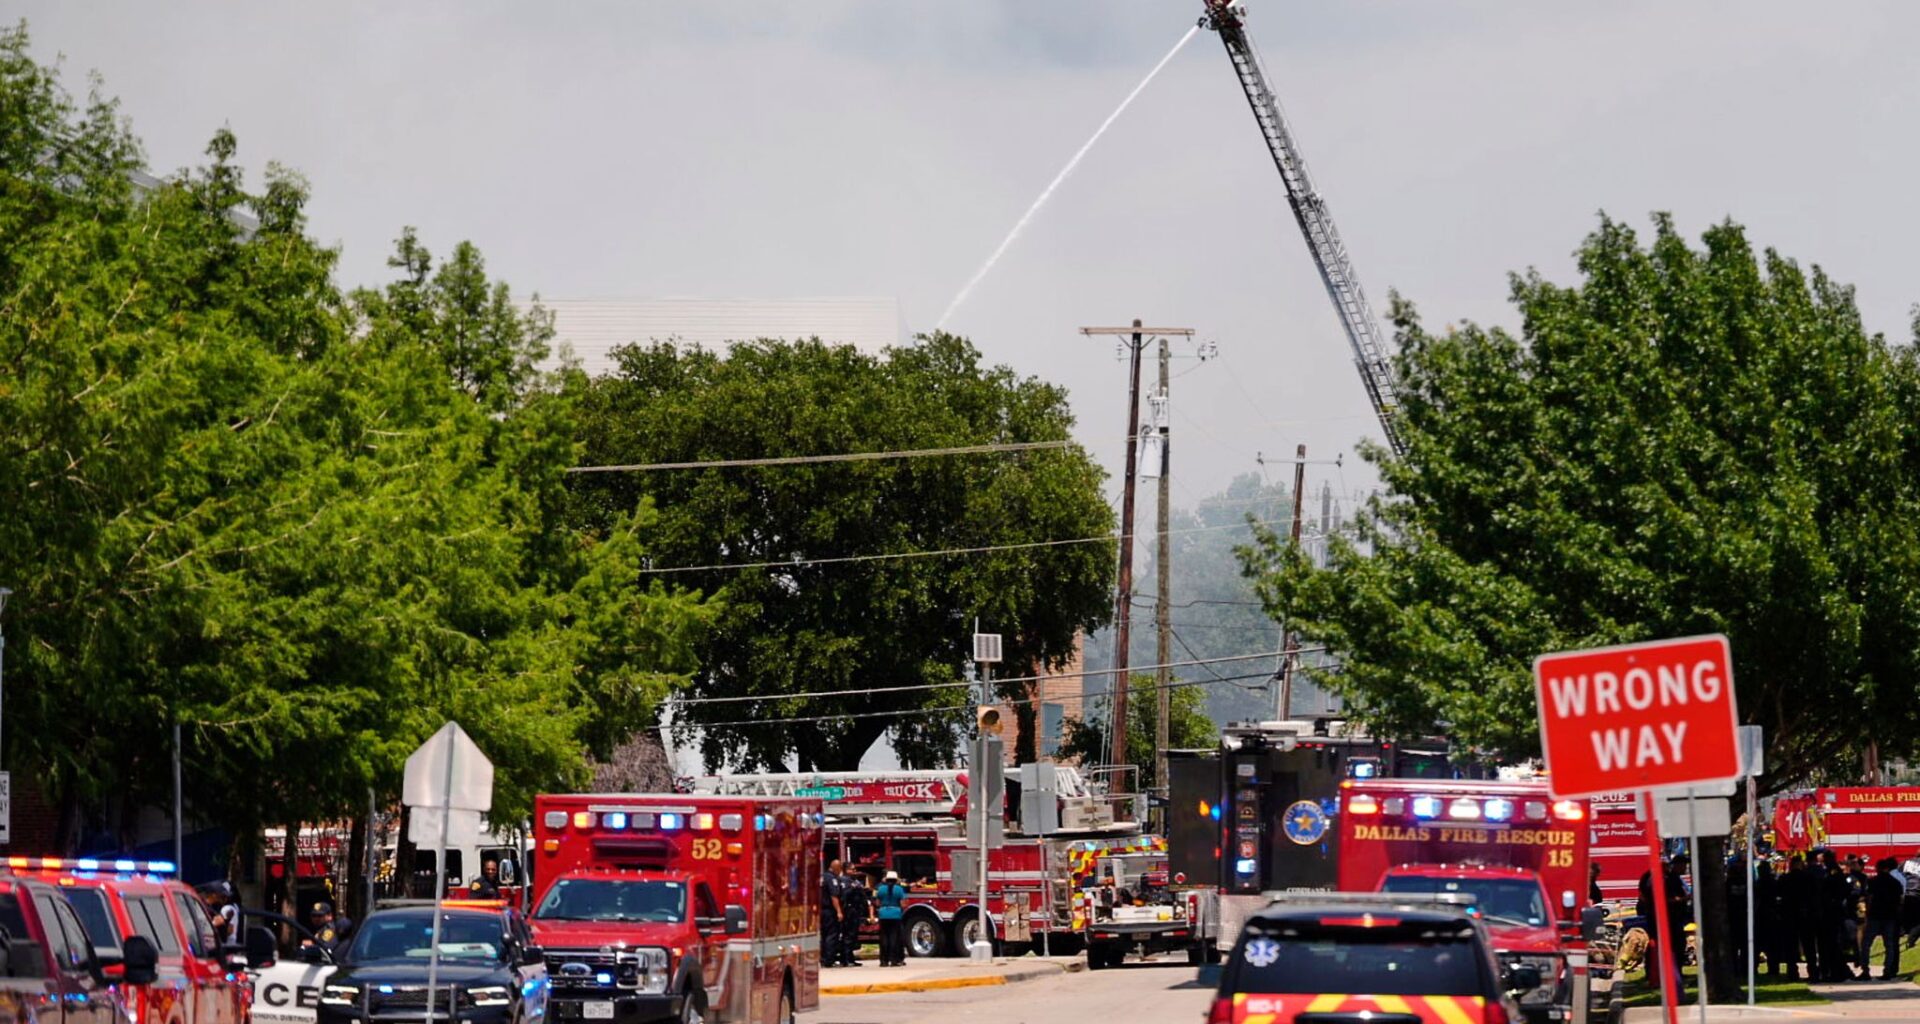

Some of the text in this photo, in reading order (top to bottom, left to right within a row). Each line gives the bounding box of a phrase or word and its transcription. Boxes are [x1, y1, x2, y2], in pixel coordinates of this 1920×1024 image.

[1549, 660, 1721, 718] WRONG
[1590, 720, 1687, 772] WAY
[883, 783, 937, 799] TRUCK
[1590, 791, 1628, 802] SCUE
[1849, 792, 1920, 803] DALLAS FIR
[1786, 811, 1805, 838] 14
[1354, 825, 1575, 845] DALLAS FIRE RESCUE
[692, 838, 722, 860] 52
[1548, 849, 1573, 867] 15
[253, 1013, 278, 1021] CHOOL
